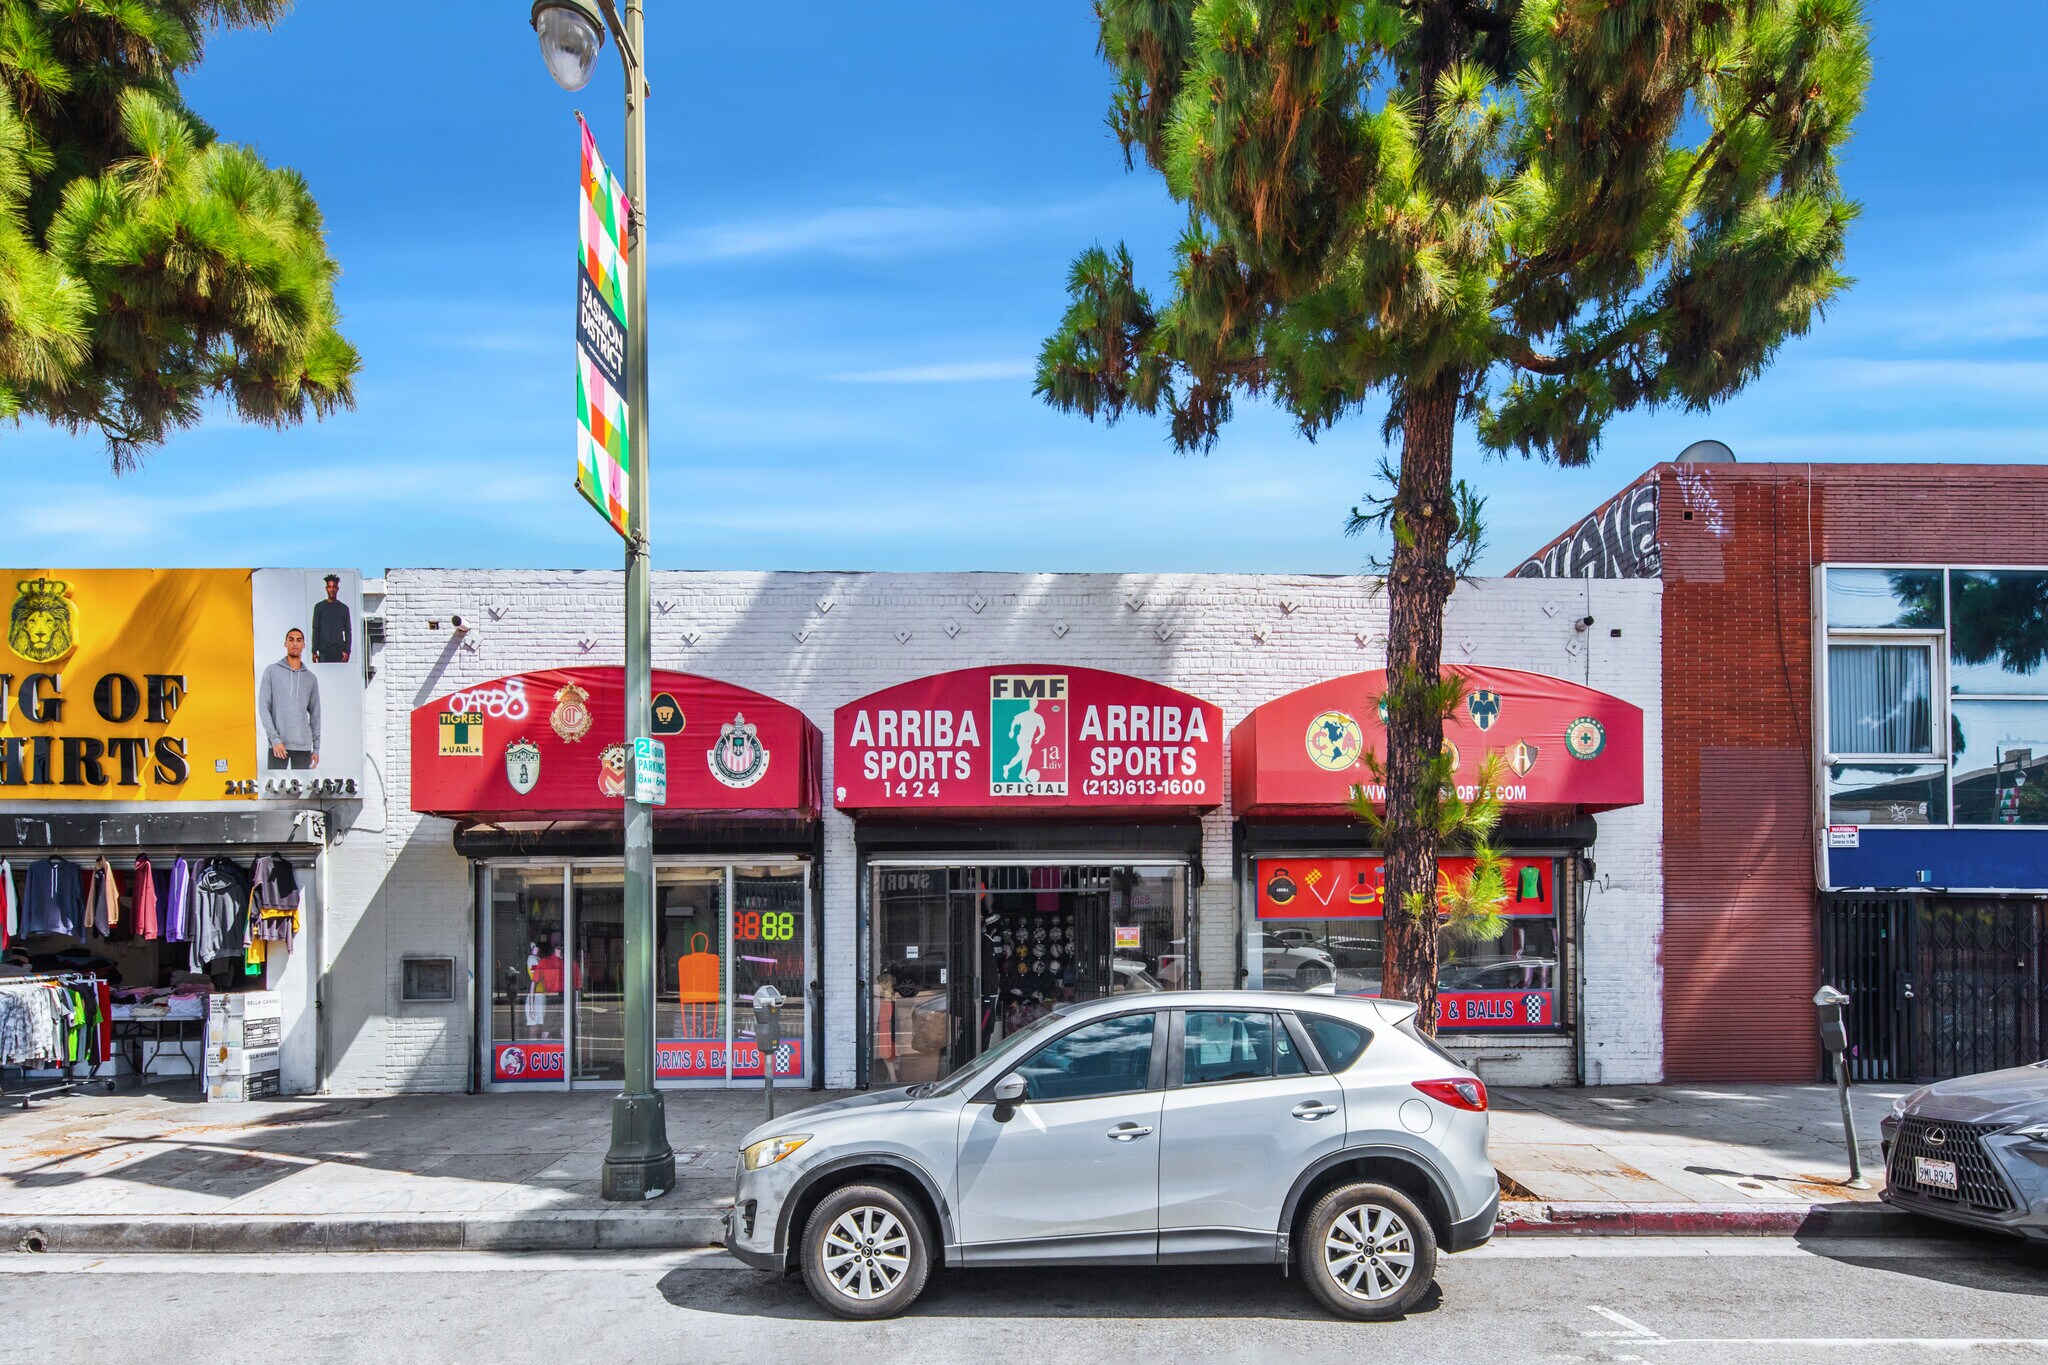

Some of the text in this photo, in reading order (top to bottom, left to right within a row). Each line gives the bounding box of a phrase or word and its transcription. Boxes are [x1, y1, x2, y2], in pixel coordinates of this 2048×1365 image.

[582, 278, 624, 356] FASHION
[581, 302, 623, 376] DISTRICT
[93, 673, 187, 723] OF
[993, 679, 1065, 698] FMF
[440, 713, 482, 724] TIGRES
[1078, 704, 1209, 743] ARRIBA
[849, 710, 980, 747] ARRIBA
[638, 741, 650, 757] 2
[638, 759, 665, 774] PARKING
[863, 750, 971, 780] SPORTS
[1049, 761, 1062, 769] div
[1090, 746, 1197, 776] SPORTS
[225, 780, 257, 795] 213
[884, 781, 940, 798] 1424
[993, 784, 1065, 794] OFICIAL
[1082, 779, 1206, 795] (213)613-1600
[1448, 1001, 1459, 1019] &
[1466, 1000, 1514, 1019] BALLS
[695, 1050, 706, 1069] &
[710, 1050, 760, 1069] BALLS
